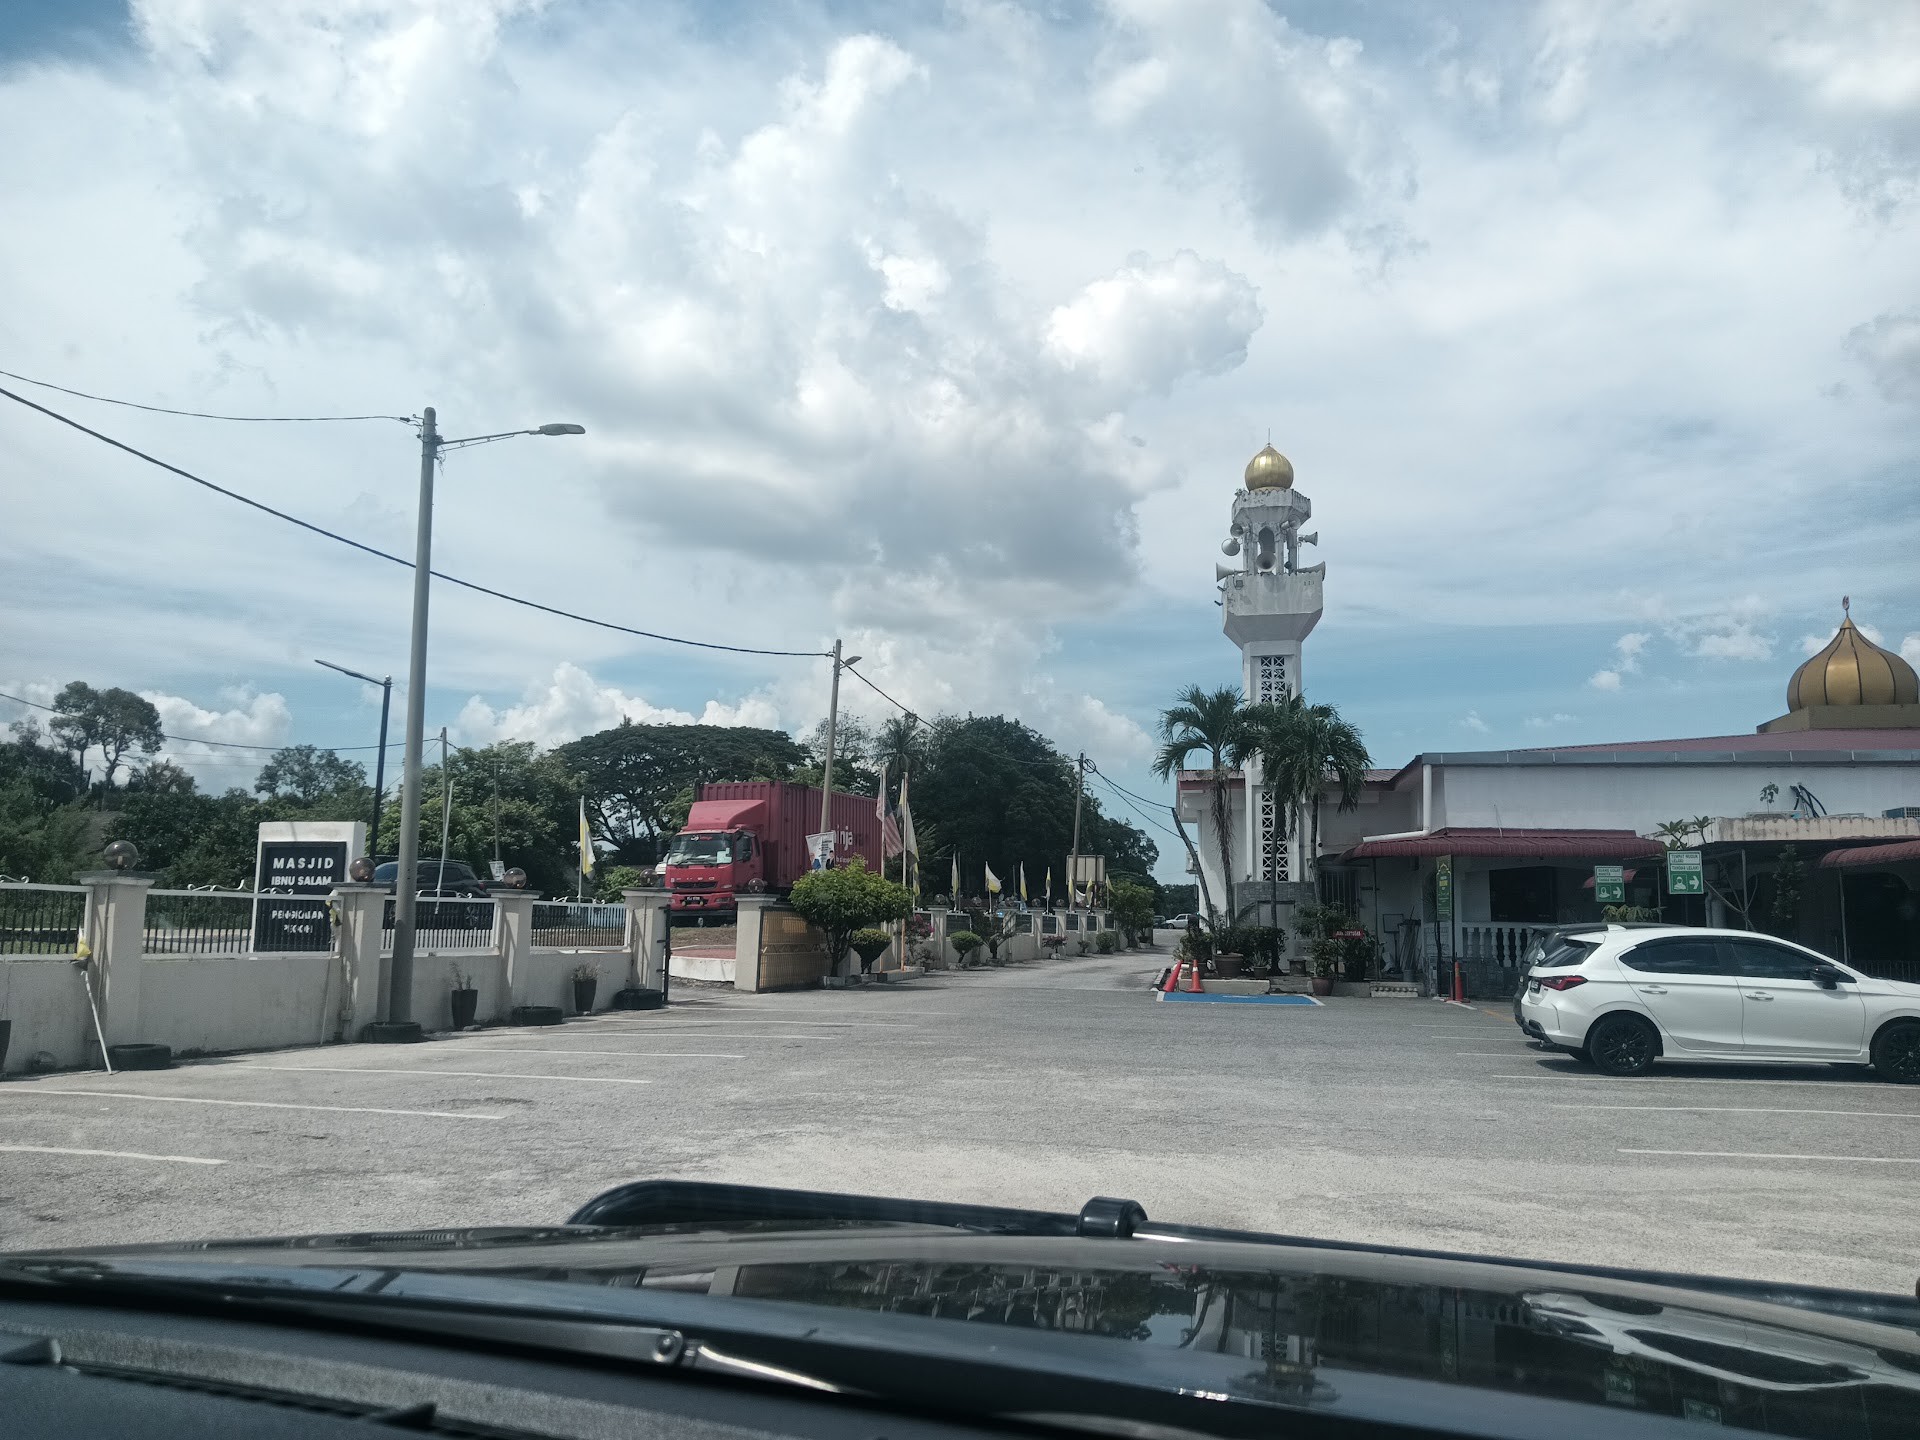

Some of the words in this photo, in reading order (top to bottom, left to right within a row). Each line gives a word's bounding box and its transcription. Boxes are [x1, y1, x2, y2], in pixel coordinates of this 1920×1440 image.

[273, 857, 334, 869] MASJID
[271, 876, 296, 886] IBNU
[297, 876, 332, 886] SALAM
